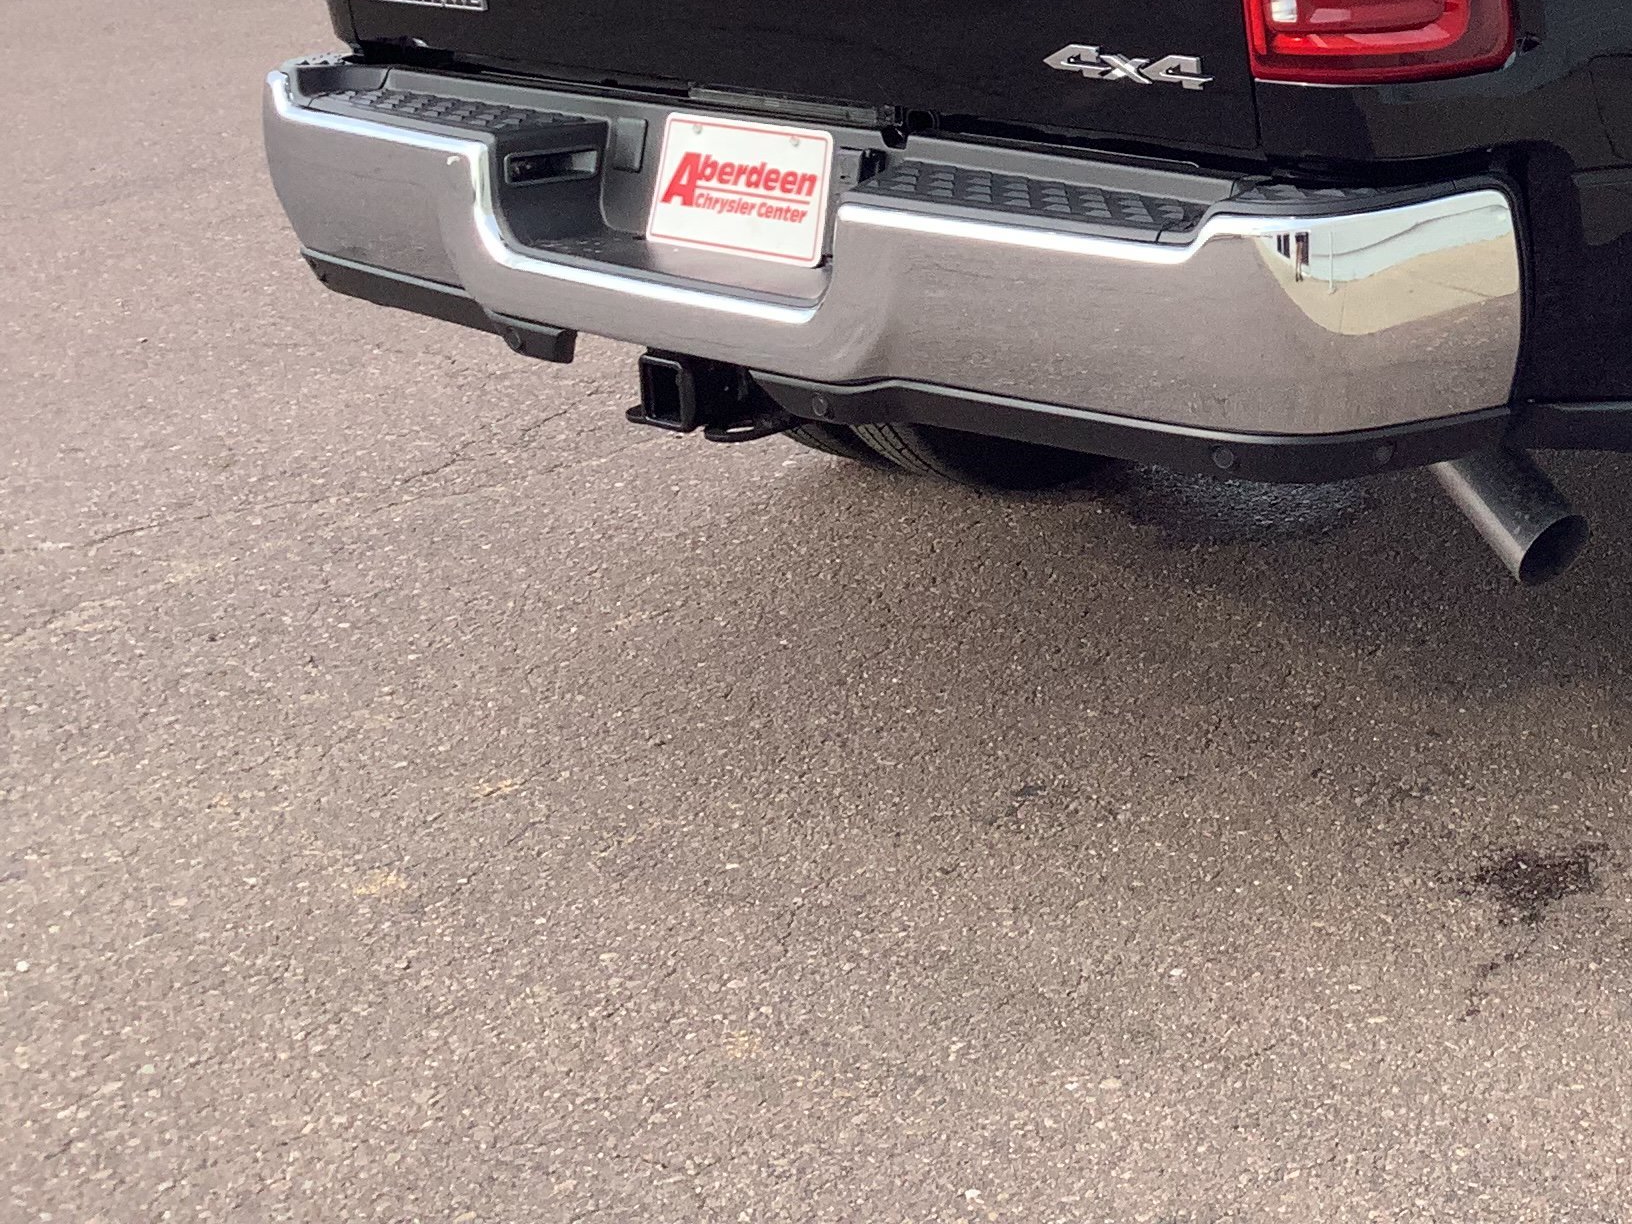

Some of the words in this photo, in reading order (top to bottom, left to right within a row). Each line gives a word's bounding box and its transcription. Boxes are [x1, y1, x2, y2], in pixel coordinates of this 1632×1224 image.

[660, 151, 818, 207] Aberdeen
[694, 192, 756, 214] Chrysler
[756, 201, 808, 224] Center
